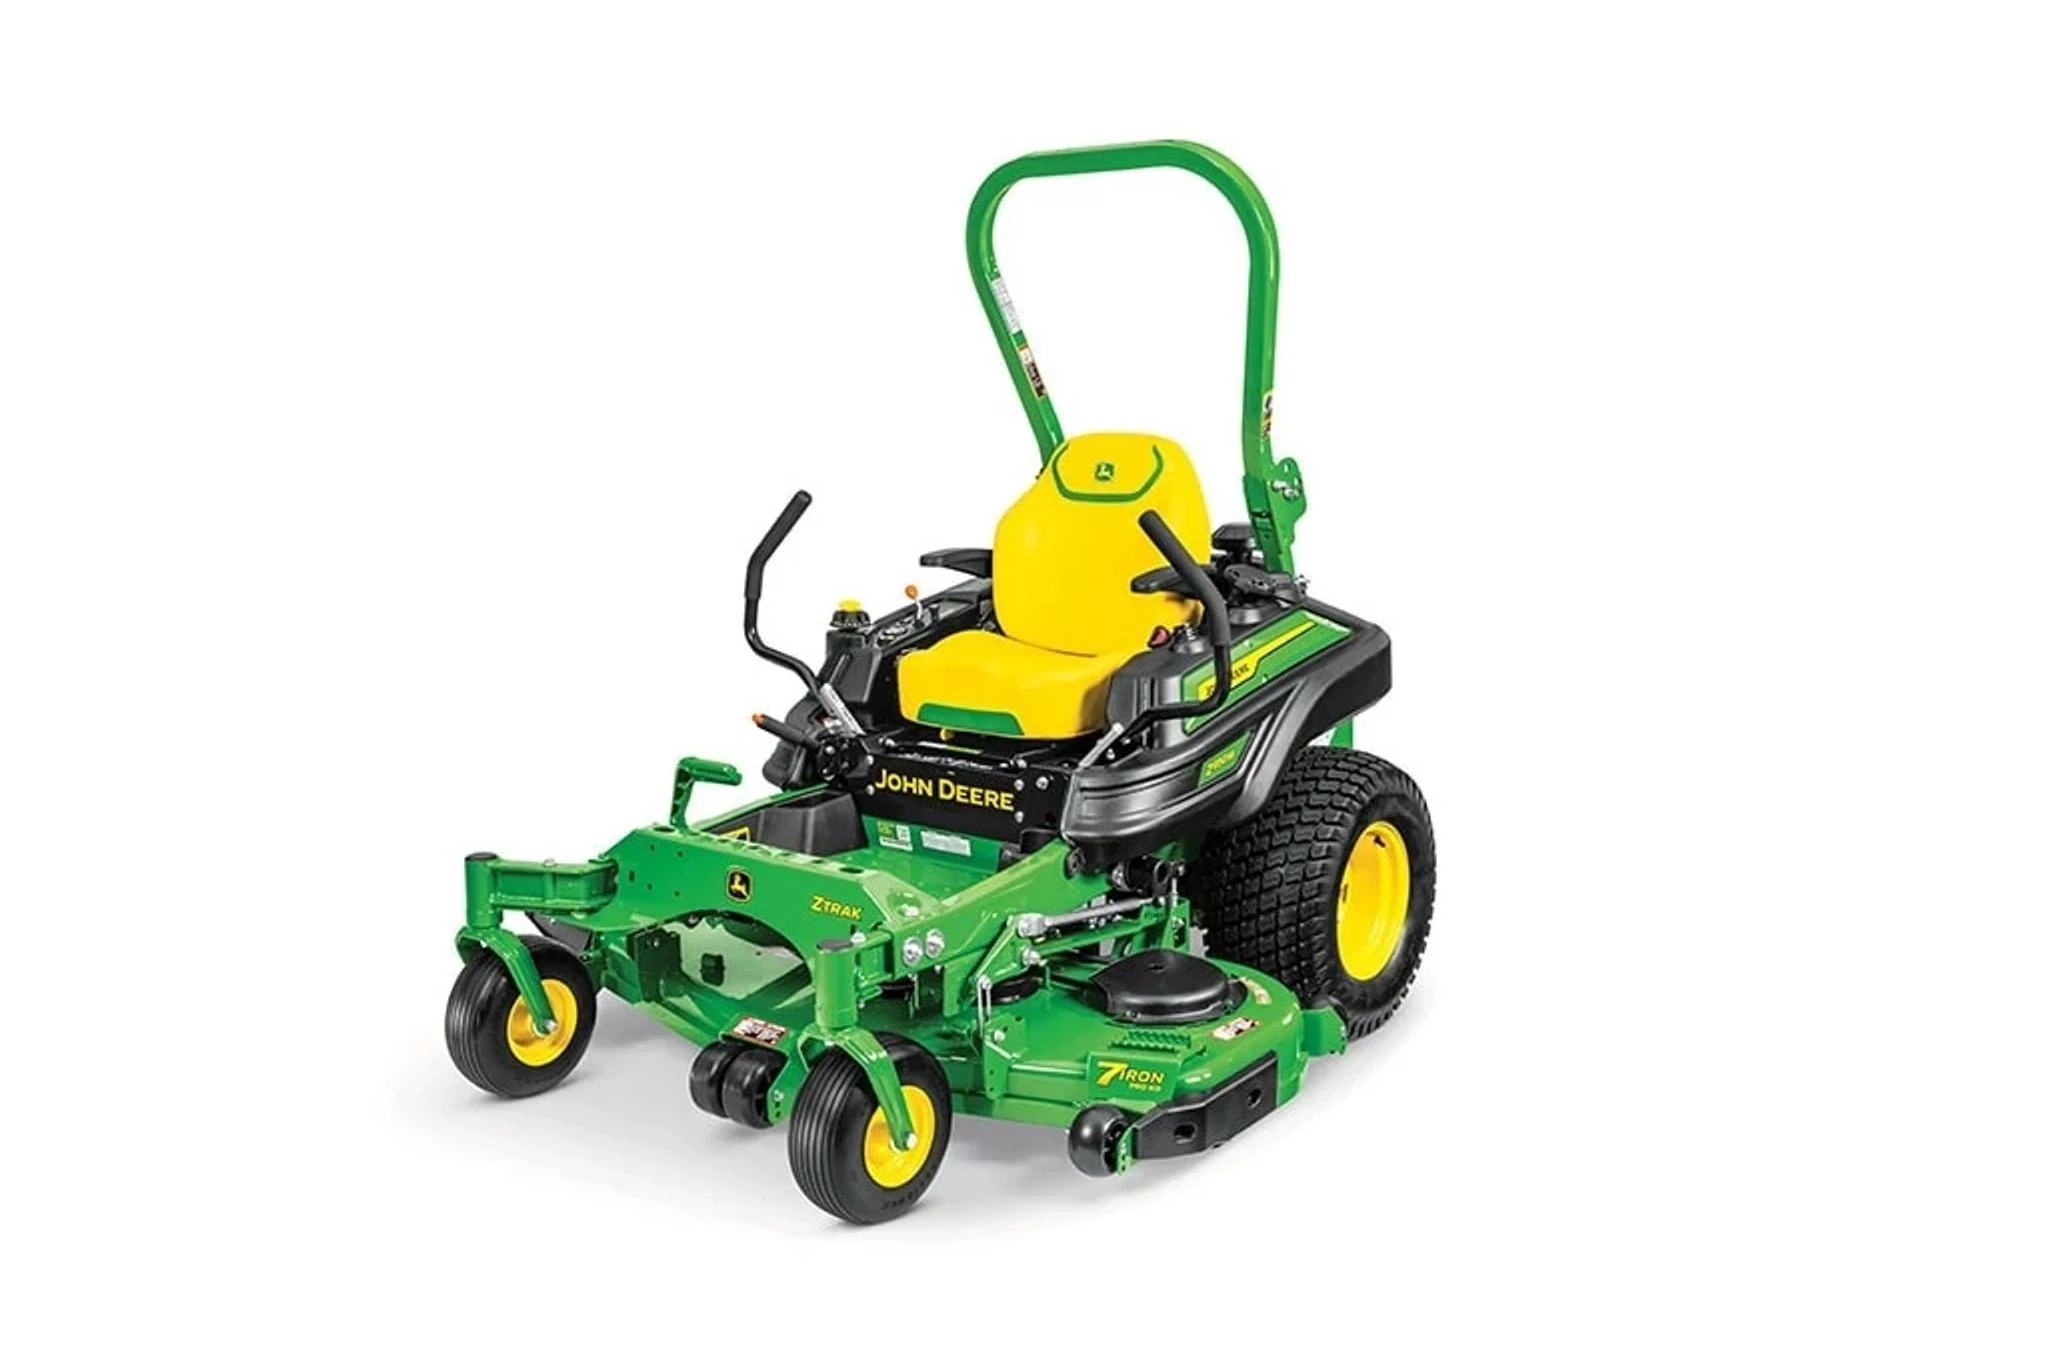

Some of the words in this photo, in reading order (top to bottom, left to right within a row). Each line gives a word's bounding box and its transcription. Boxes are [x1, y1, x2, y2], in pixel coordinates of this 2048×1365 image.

[875, 768, 933, 797] JOHN
[938, 777, 1015, 811] DEERE
[811, 895, 862, 920] ZTRAK
